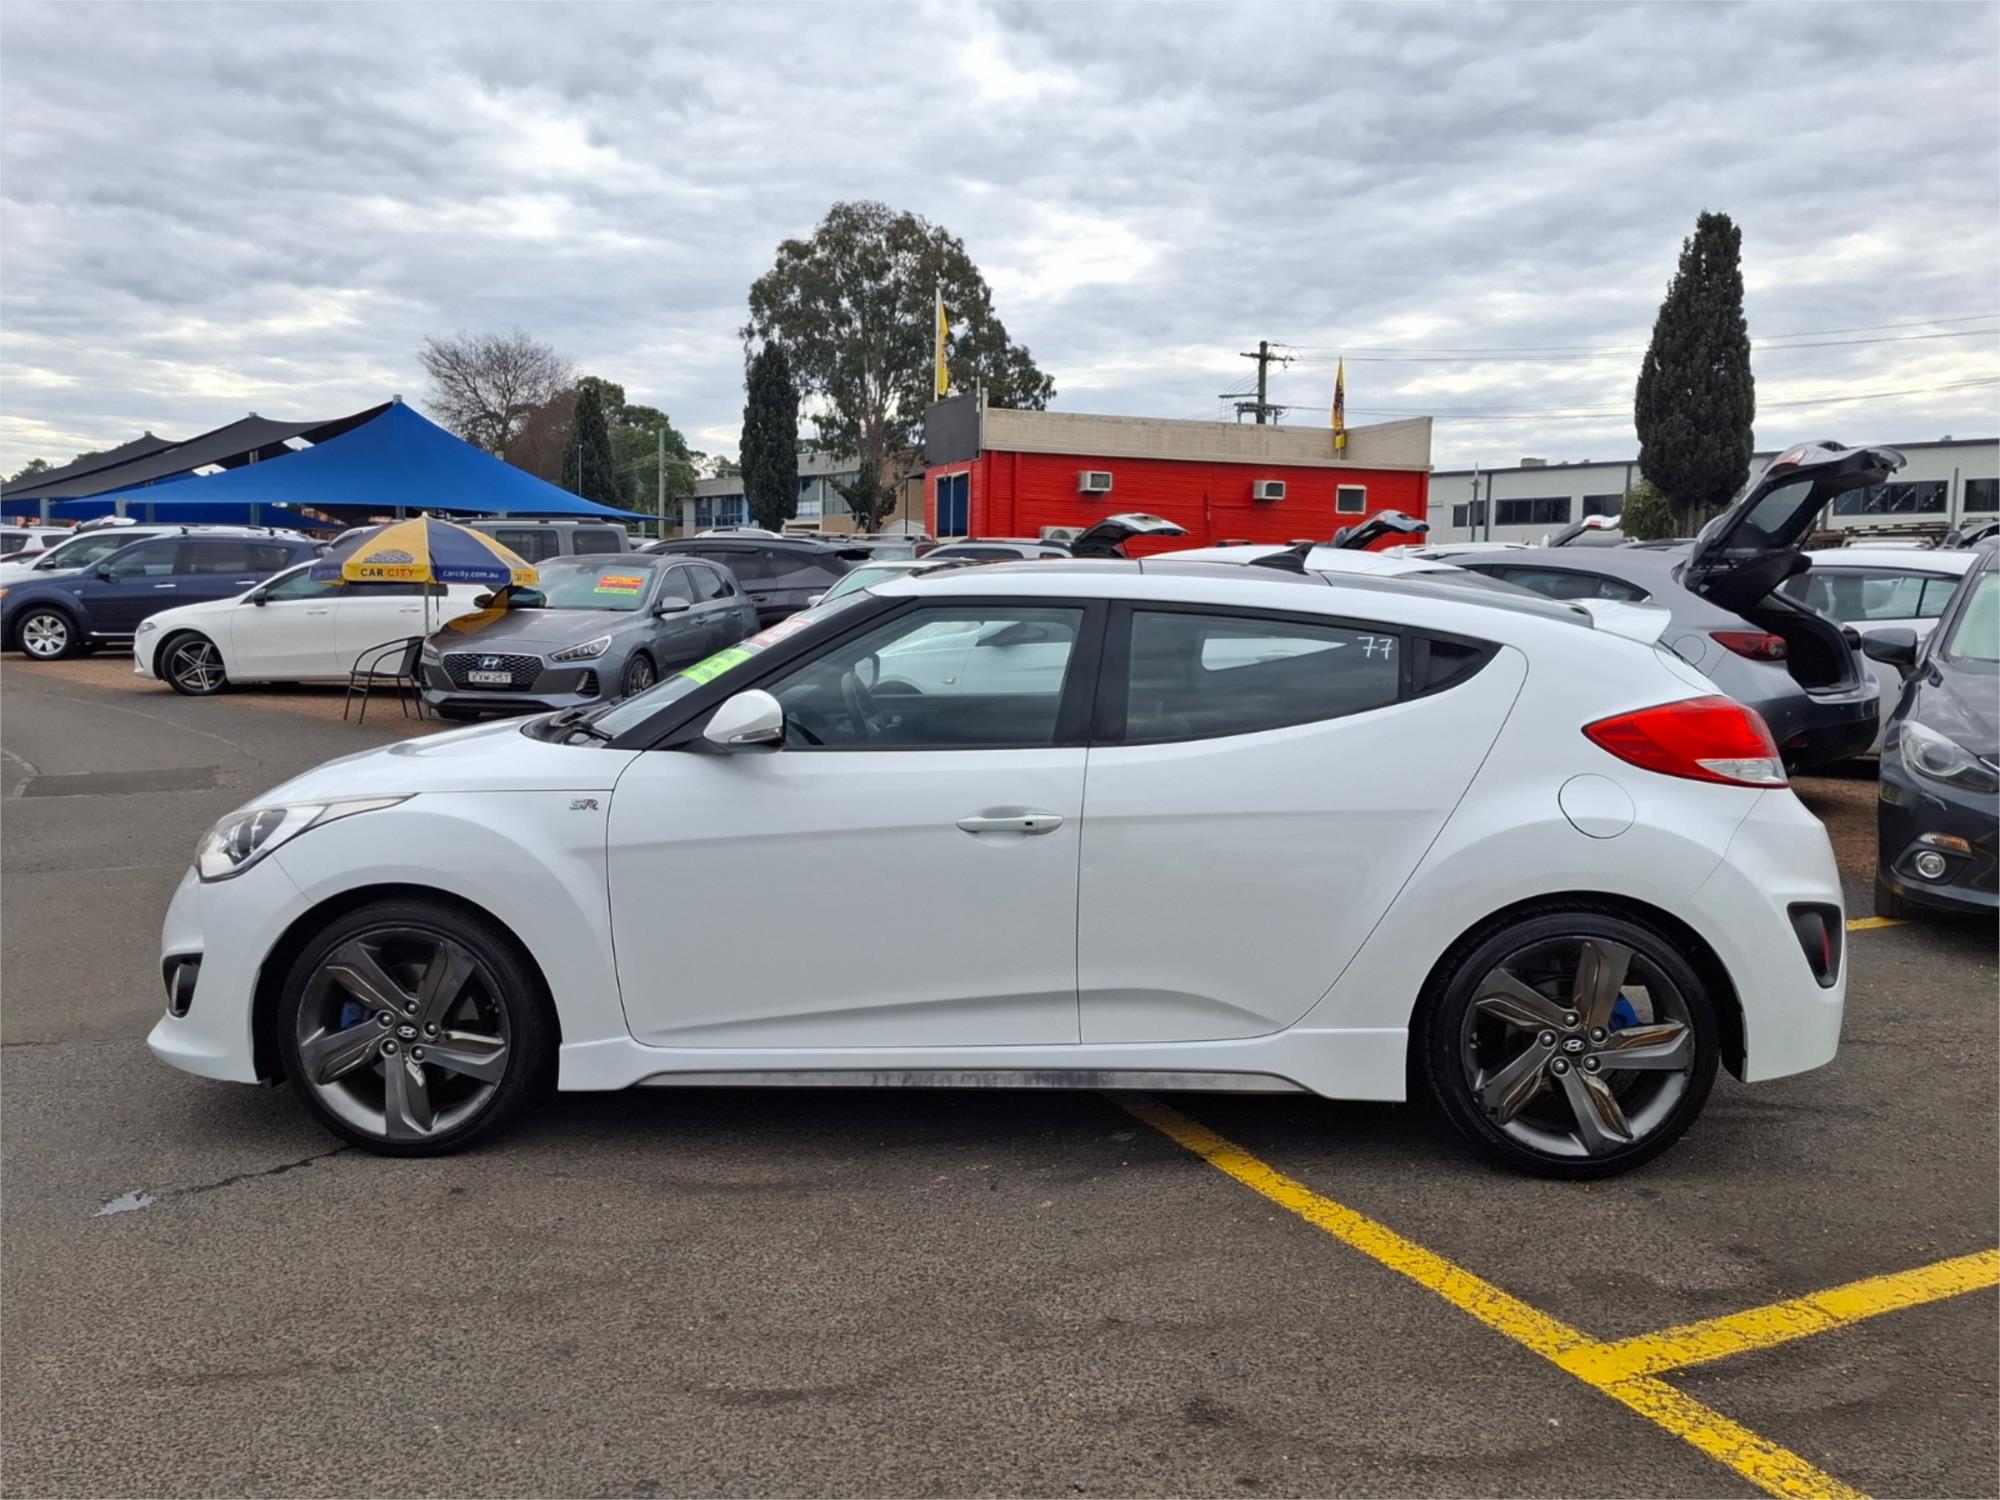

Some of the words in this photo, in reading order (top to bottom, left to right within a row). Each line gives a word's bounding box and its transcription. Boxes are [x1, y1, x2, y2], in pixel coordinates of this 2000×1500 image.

[360, 568, 383, 577] CAR
[387, 568, 415, 577] CITY
[442, 569, 498, 579] carcity.com.au
[1357, 636, 1392, 660] 77
